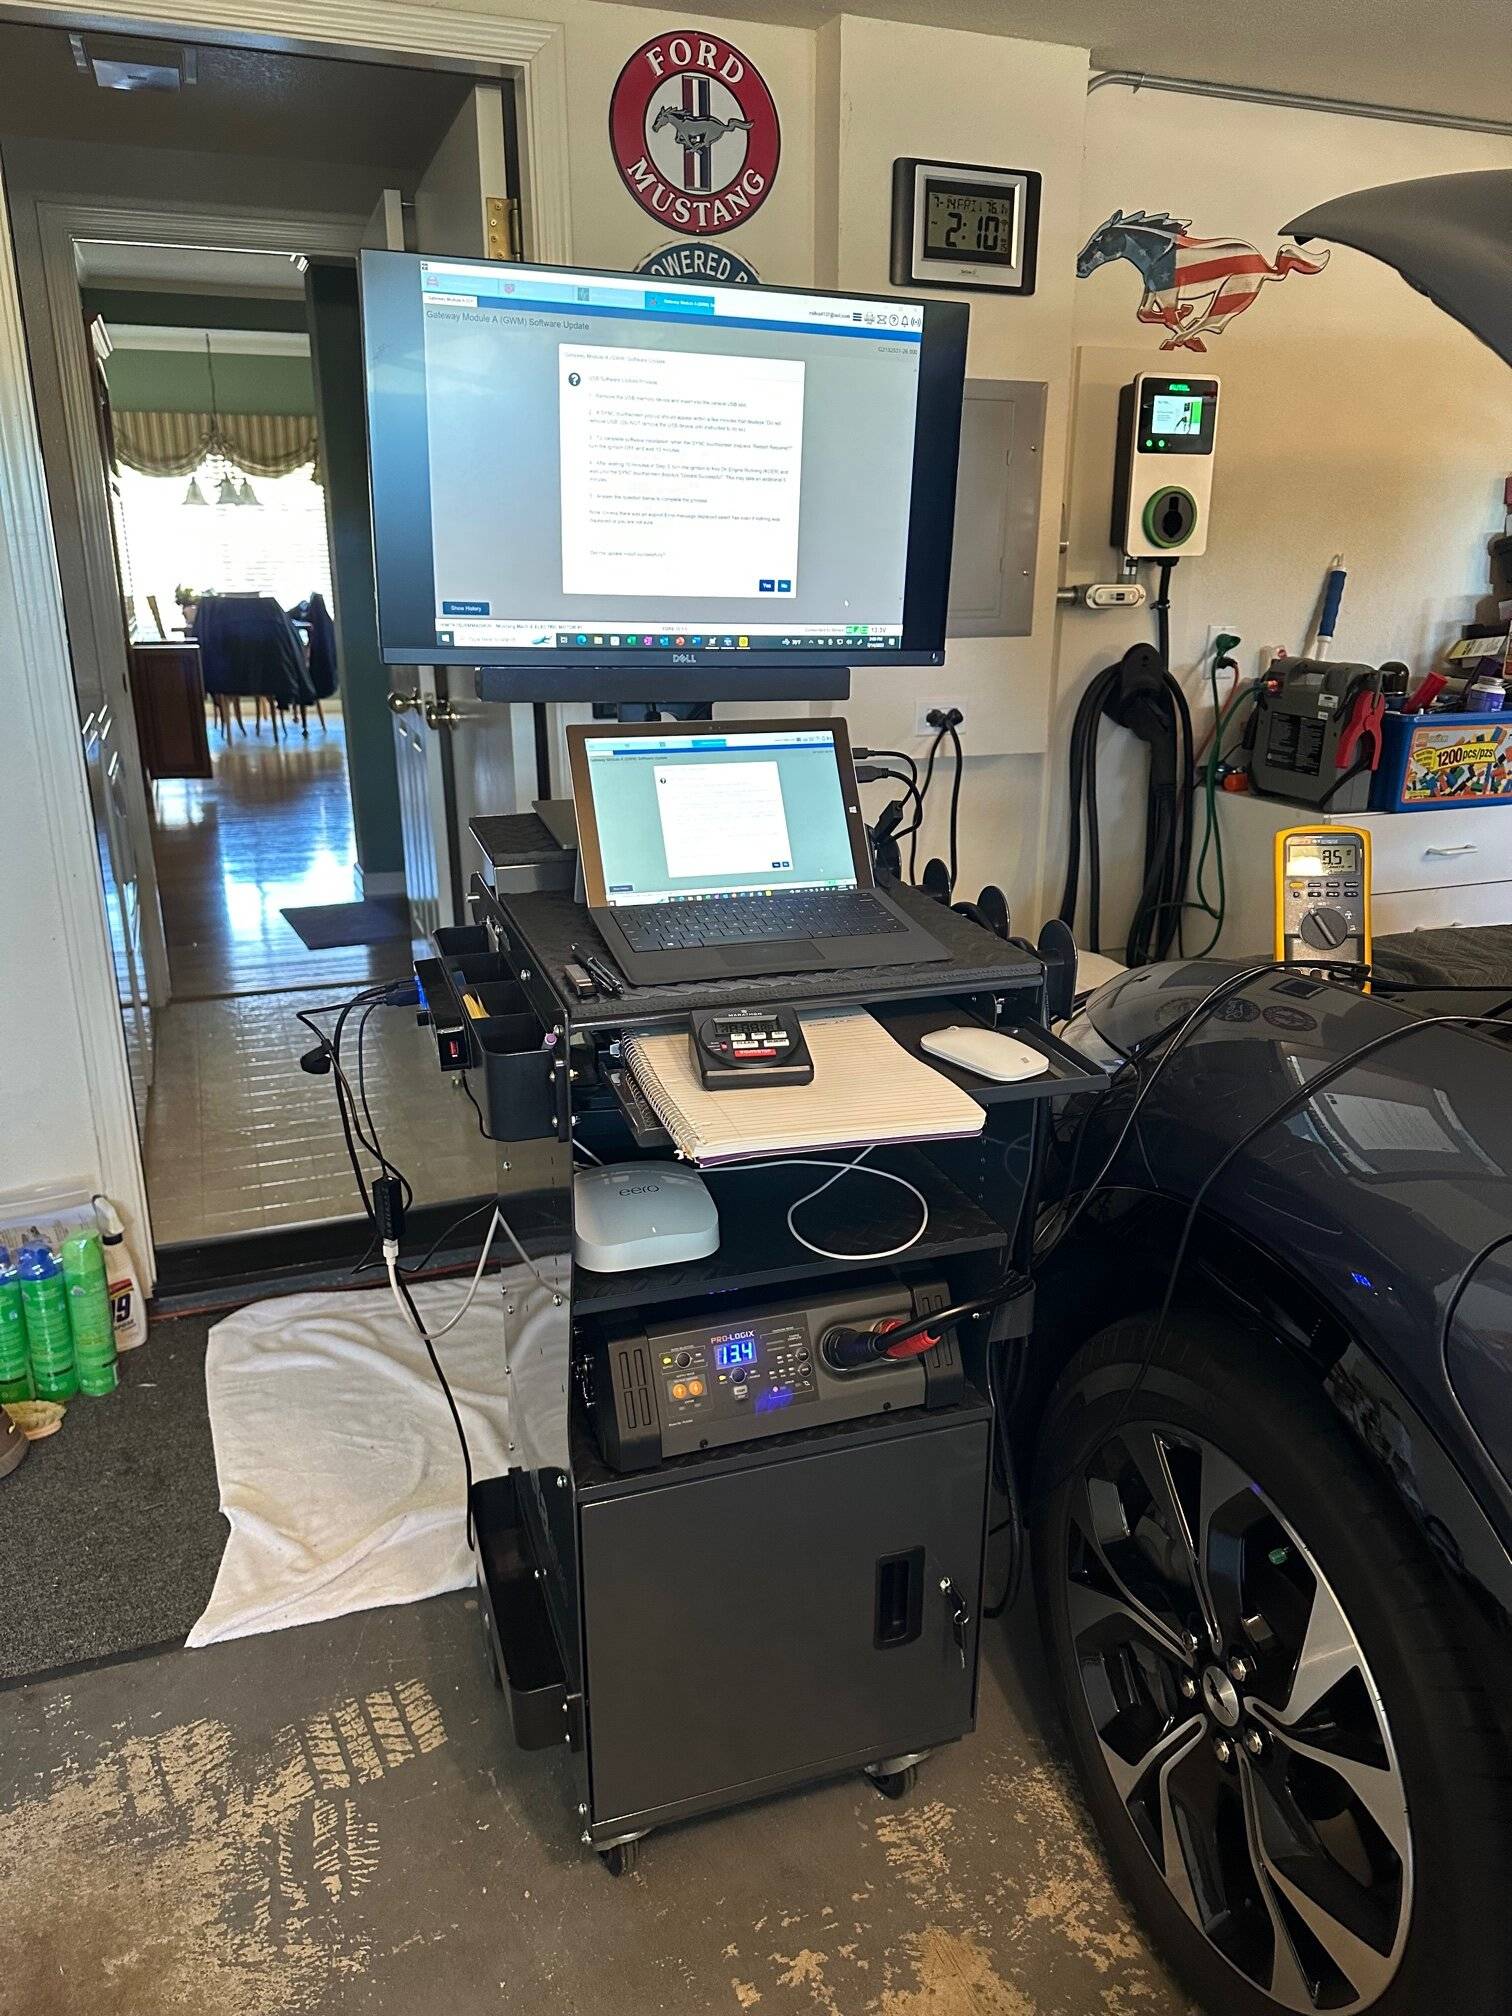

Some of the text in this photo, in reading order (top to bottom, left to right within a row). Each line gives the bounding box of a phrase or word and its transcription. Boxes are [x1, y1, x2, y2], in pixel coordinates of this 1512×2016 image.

[645, 39, 745, 84] FORD
[627, 156, 765, 227] MUSTANG
[944, 211, 1000, 251] 2:10
[426, 310, 460, 322] Gateway
[462, 313, 490, 323] Module
[500, 316, 528, 327] (GWM)
[529, 319, 562, 329] Software
[563, 321, 590, 331] Update
[672, 654, 697, 664] DELL
[1436, 747, 1494, 767] 1200 pcs/pzs
[619, 1184, 661, 1197] eero
[710, 1330, 755, 1345] PRO-LOGIX
